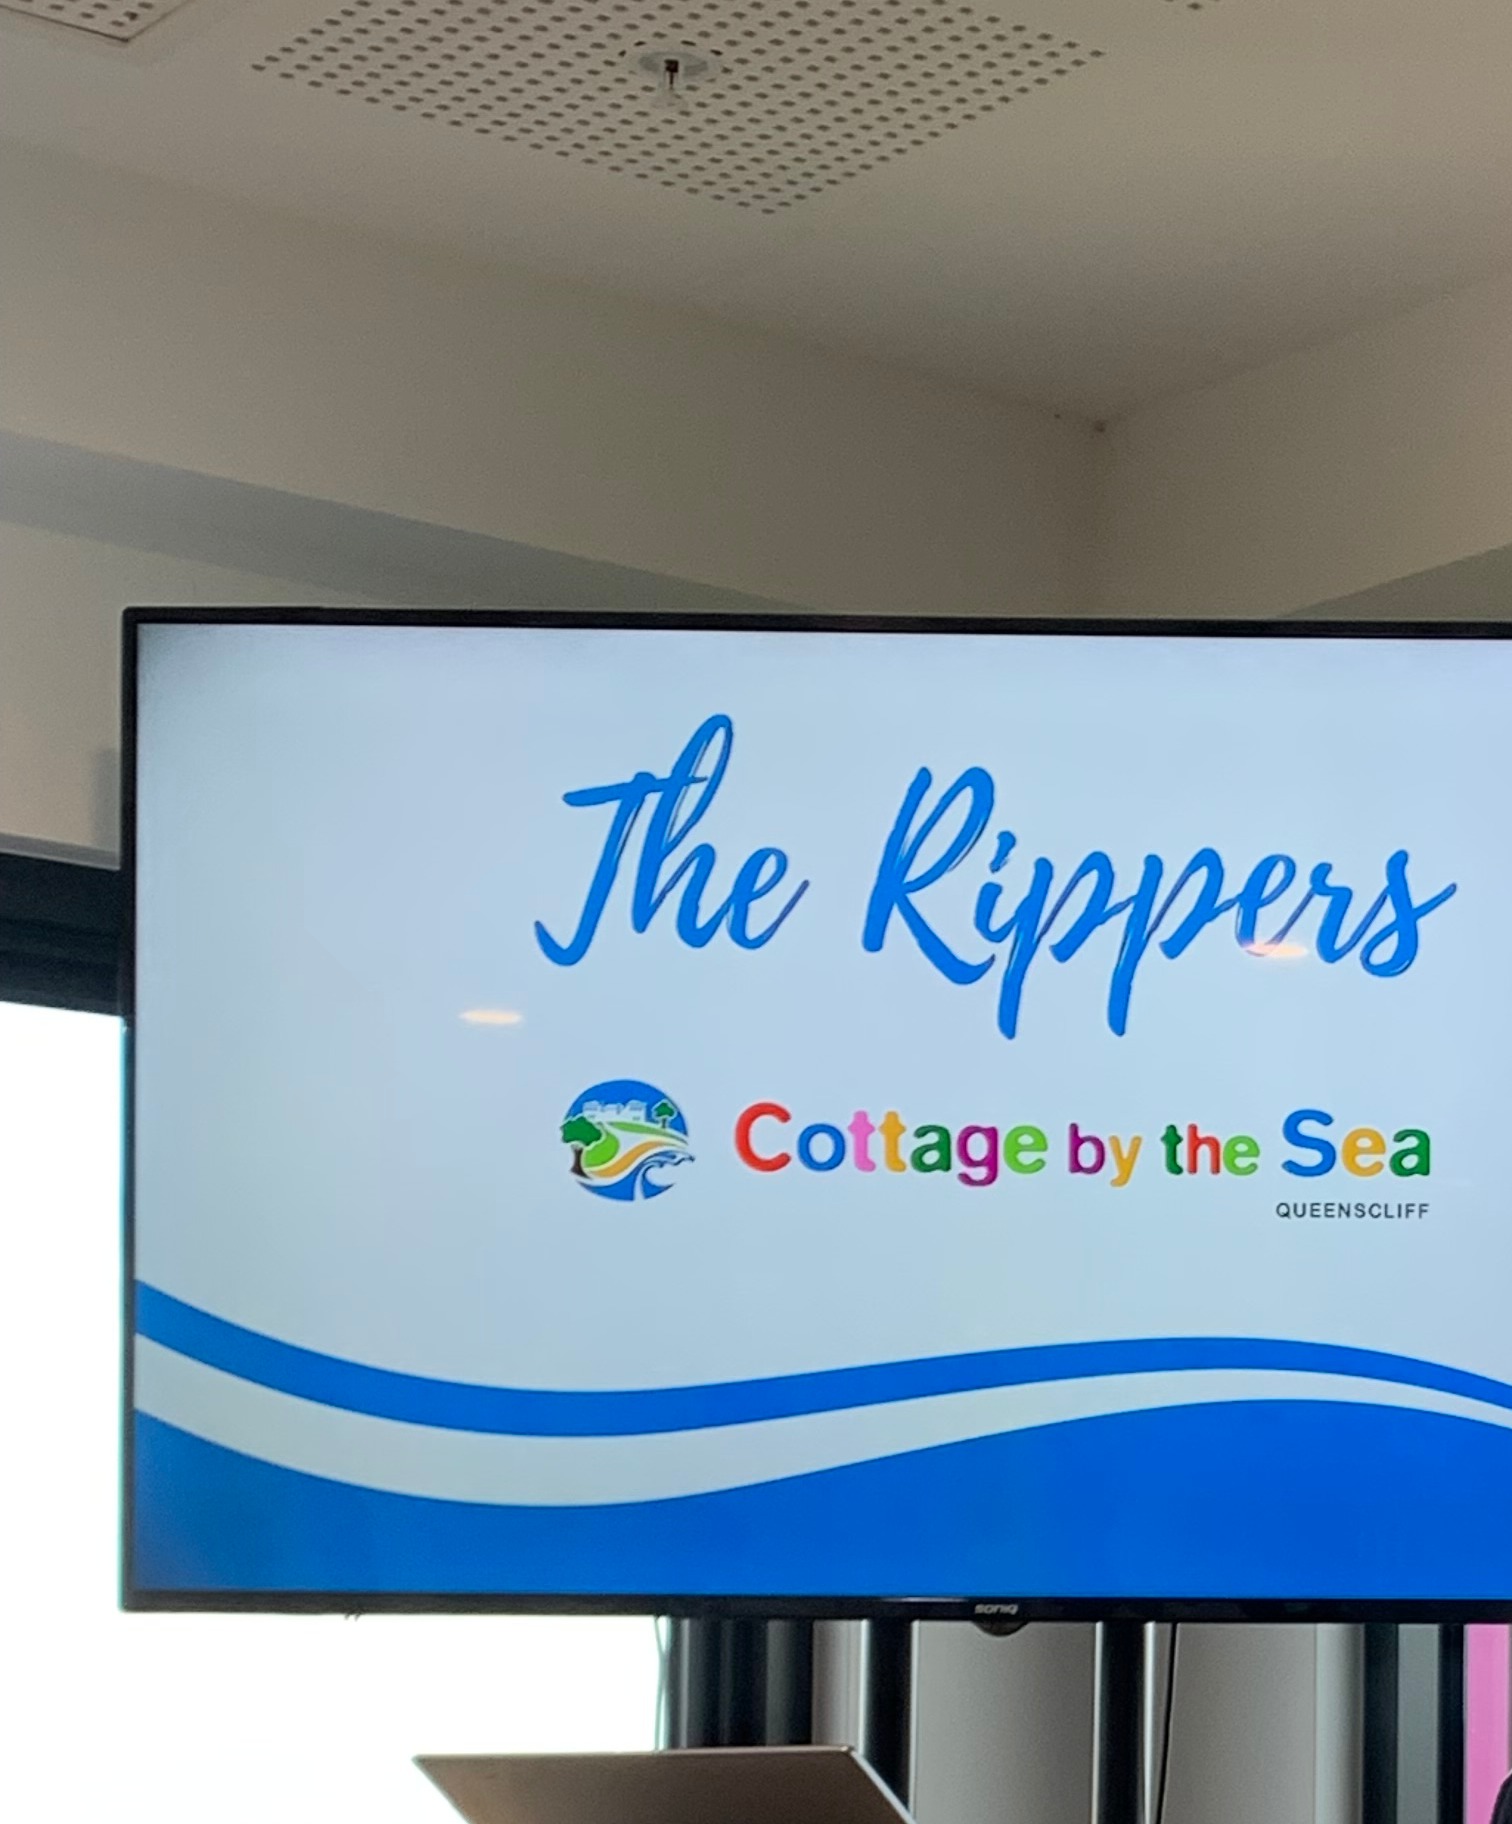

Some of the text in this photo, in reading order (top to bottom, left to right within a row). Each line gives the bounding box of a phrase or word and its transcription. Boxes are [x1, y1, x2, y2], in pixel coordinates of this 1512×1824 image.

[534, 713, 1458, 1041] The Rippers
[734, 1101, 1432, 1188] Cottage by the Sea
[1275, 1202, 1430, 1220] QUEENSCLIFF
